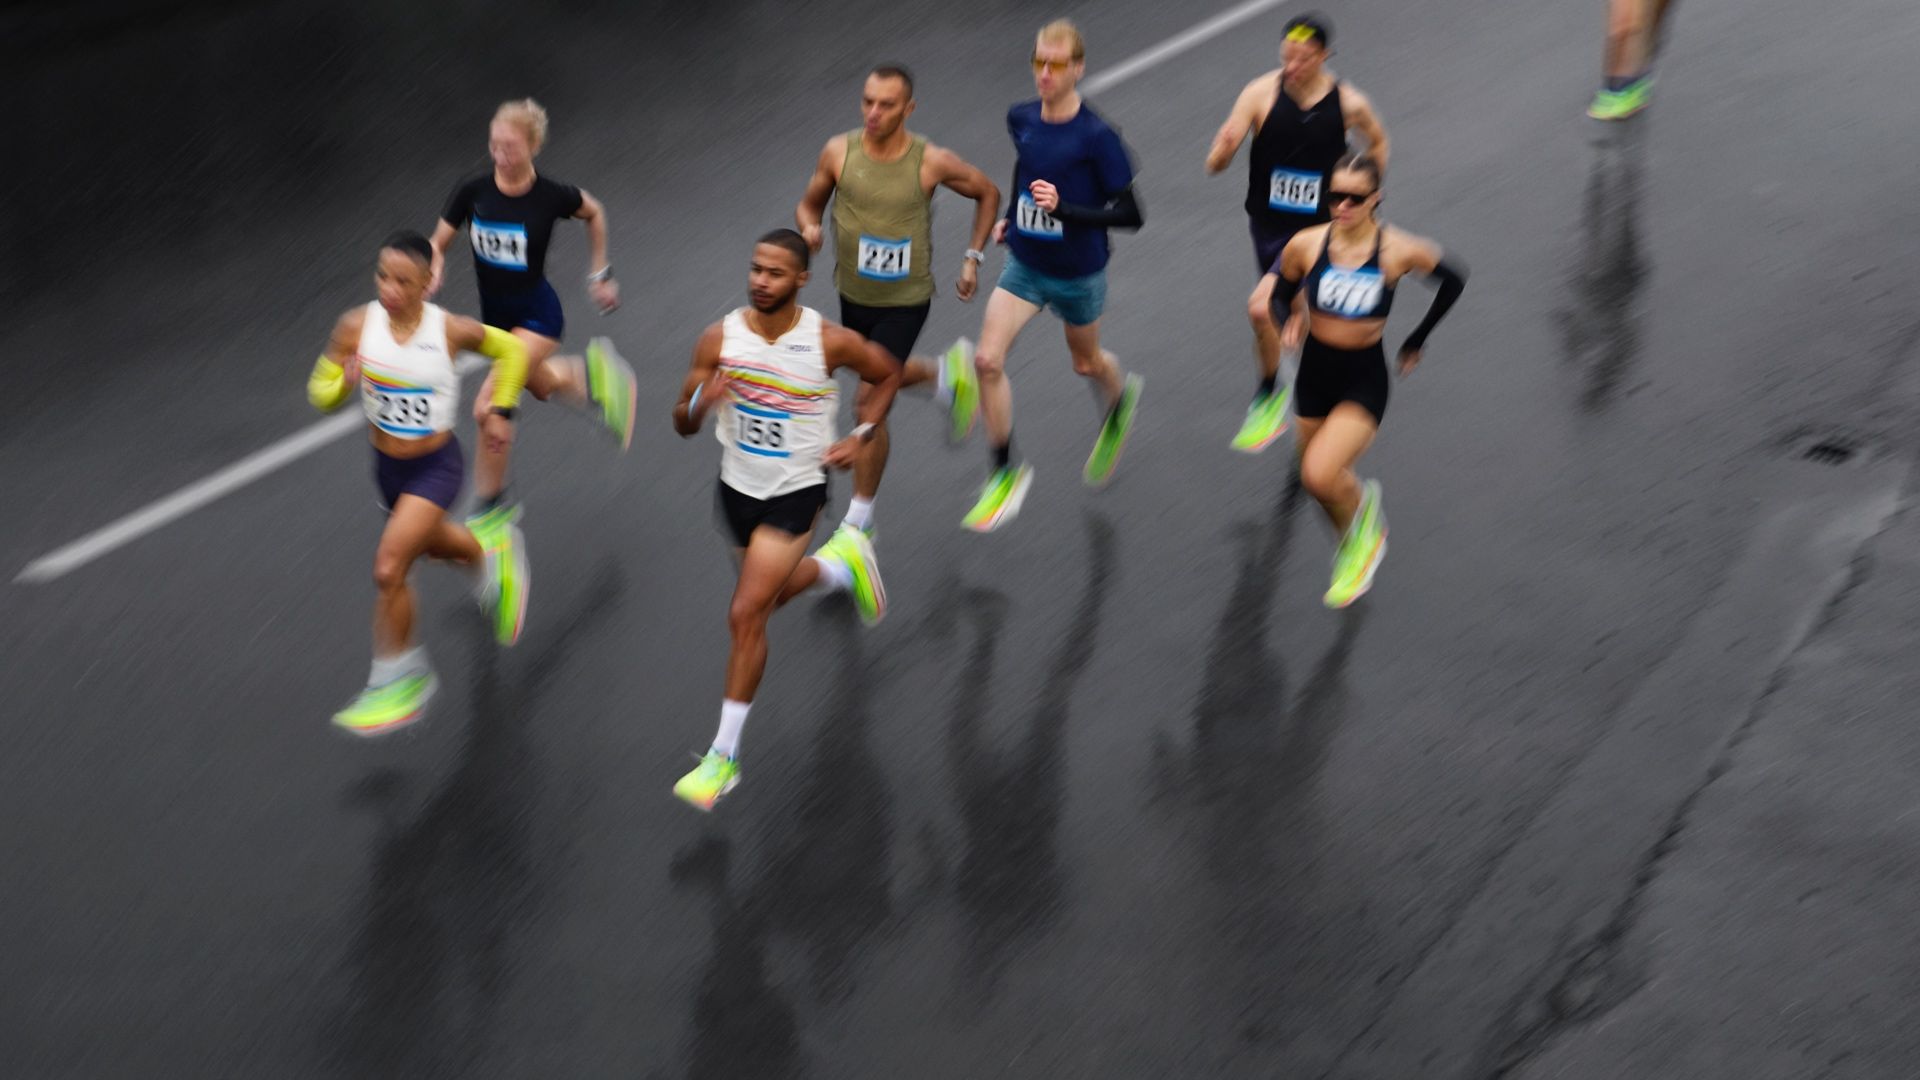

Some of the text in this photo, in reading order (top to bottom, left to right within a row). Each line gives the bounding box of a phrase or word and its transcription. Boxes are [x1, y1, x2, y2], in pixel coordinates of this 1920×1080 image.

[864, 242, 904, 273] 221
[378, 394, 431, 424] 239
[737, 414, 785, 448] 158
